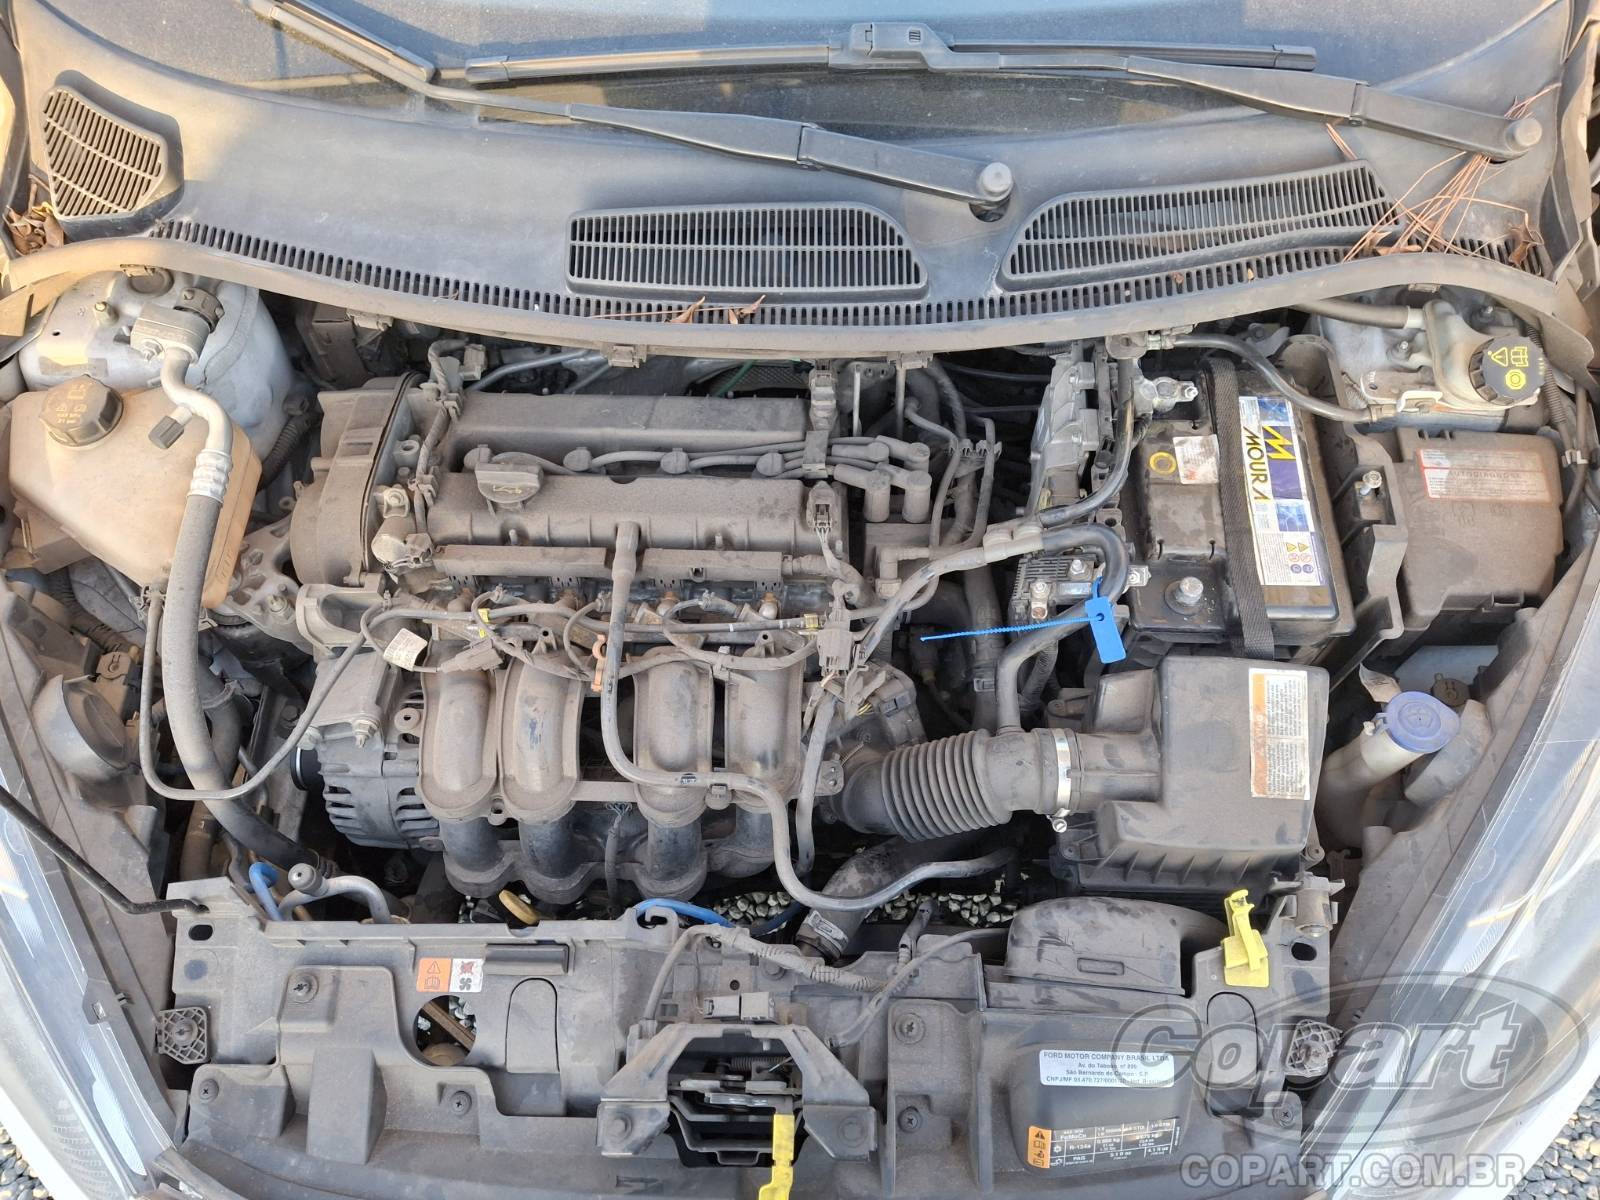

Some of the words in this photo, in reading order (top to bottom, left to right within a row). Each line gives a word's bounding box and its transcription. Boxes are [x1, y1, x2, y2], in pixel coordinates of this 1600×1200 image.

[1243, 425, 1272, 501] MOURA
[1043, 1051, 1063, 1059] FORD
[1065, 1052, 1090, 1060] MOTOR
[1091, 1053, 1124, 1061] COMPANY
